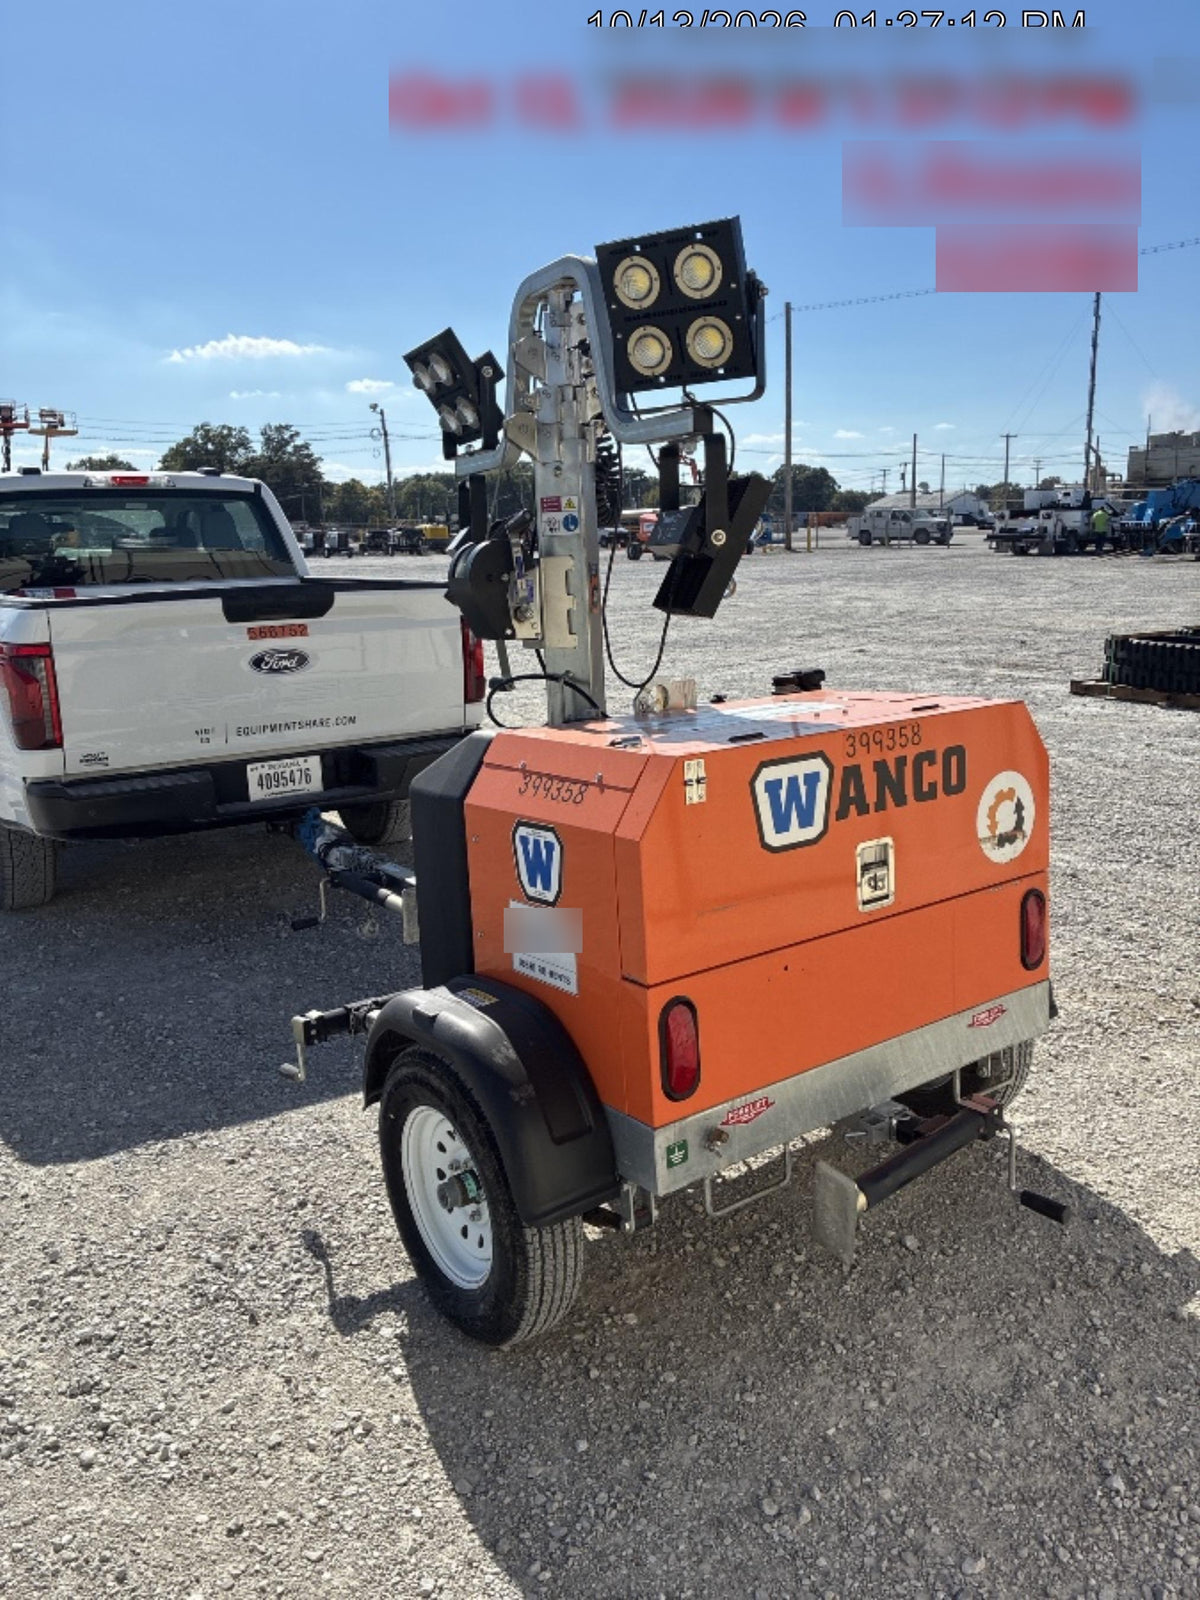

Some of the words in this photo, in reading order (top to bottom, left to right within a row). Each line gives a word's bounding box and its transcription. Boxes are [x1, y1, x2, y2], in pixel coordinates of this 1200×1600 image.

[235, 715, 358, 738] EQUIPMENTSHARE.COM
[844, 723, 923, 759] 399358
[256, 767, 312, 791] 4095476
[518, 773, 589, 805] 399358
[762, 744, 967, 836] WANCO
[518, 834, 556, 892] W
